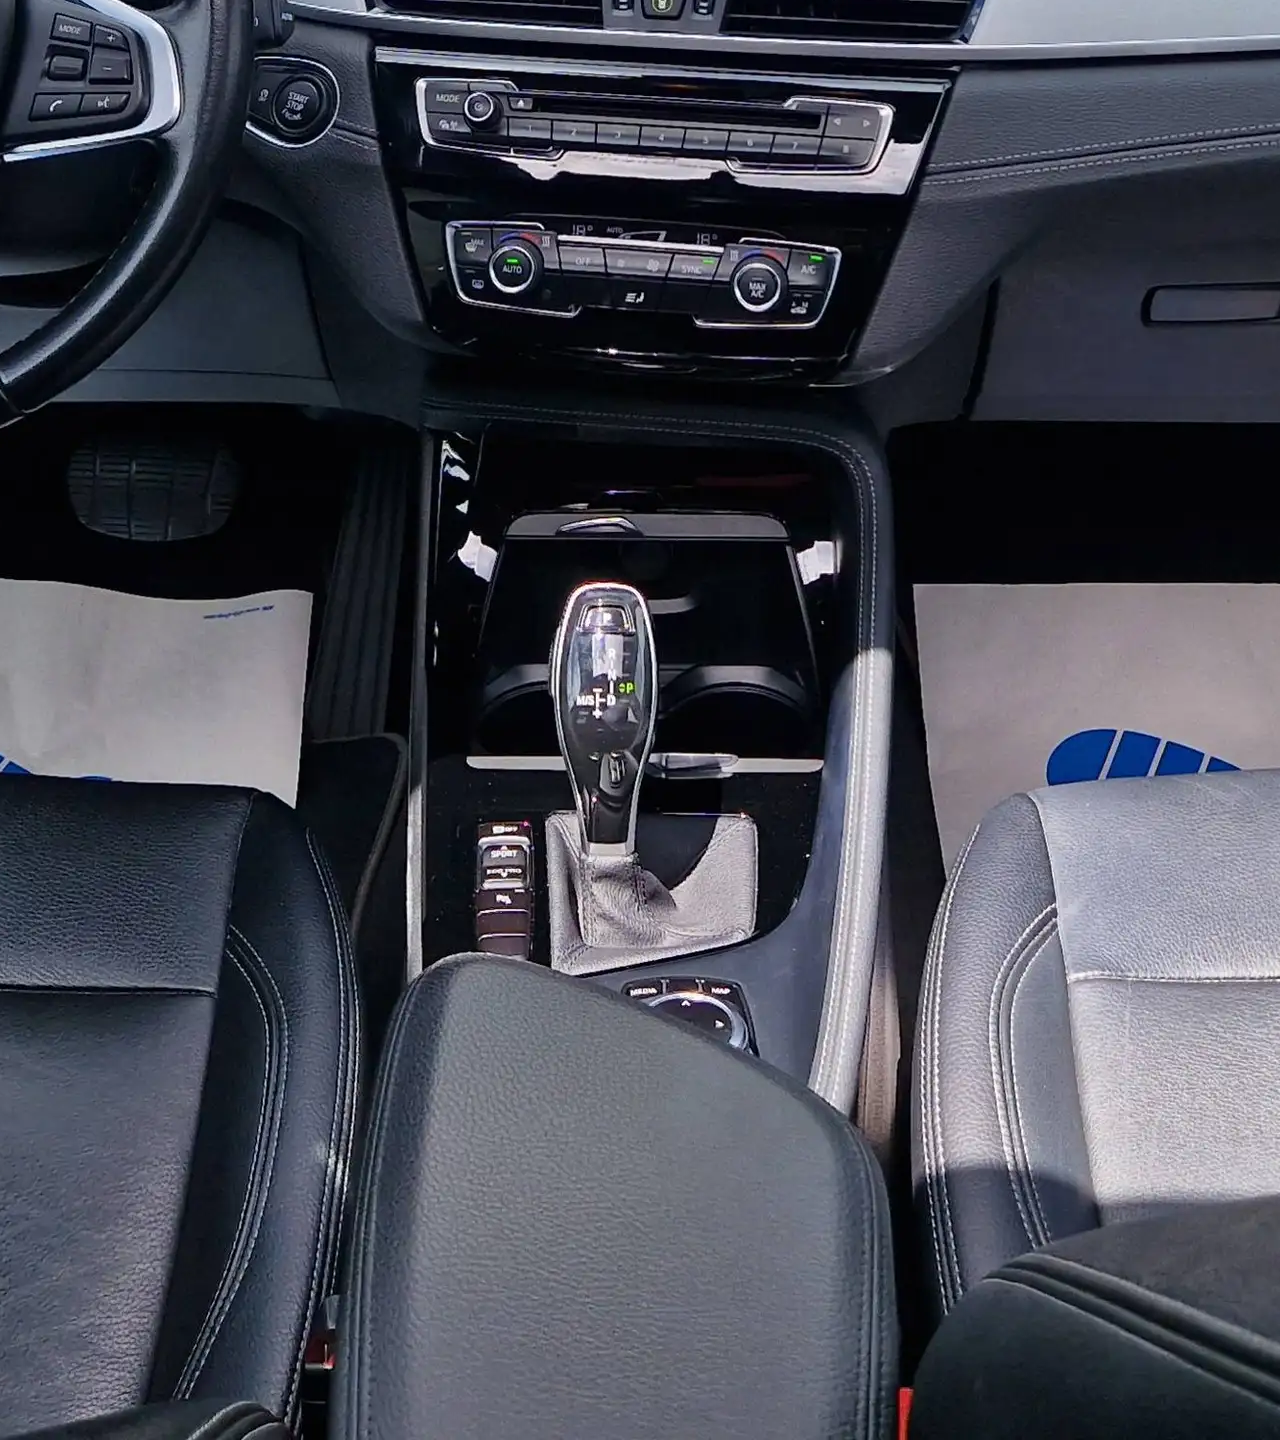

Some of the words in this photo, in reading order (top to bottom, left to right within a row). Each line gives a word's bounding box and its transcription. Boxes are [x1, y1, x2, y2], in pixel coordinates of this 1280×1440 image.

[59, 24, 81, 35] MODE
[288, 91, 310, 103] START
[436, 93, 460, 103] MODE
[285, 100, 304, 111] STOP
[502, 265, 522, 274] AUTO
[681, 265, 702, 274] SYNC
[800, 264, 816, 274] A/C
[749, 281, 766, 291] MAX
[751, 290, 764, 299] A/C
[608, 648, 616, 659] R
[607, 669, 617, 680] N
[626, 682, 634, 694] P
[606, 694, 616, 706] D
[490, 849, 518, 858] SPORT
[629, 987, 658, 997] MEDIA
[711, 987, 731, 995] MAP
